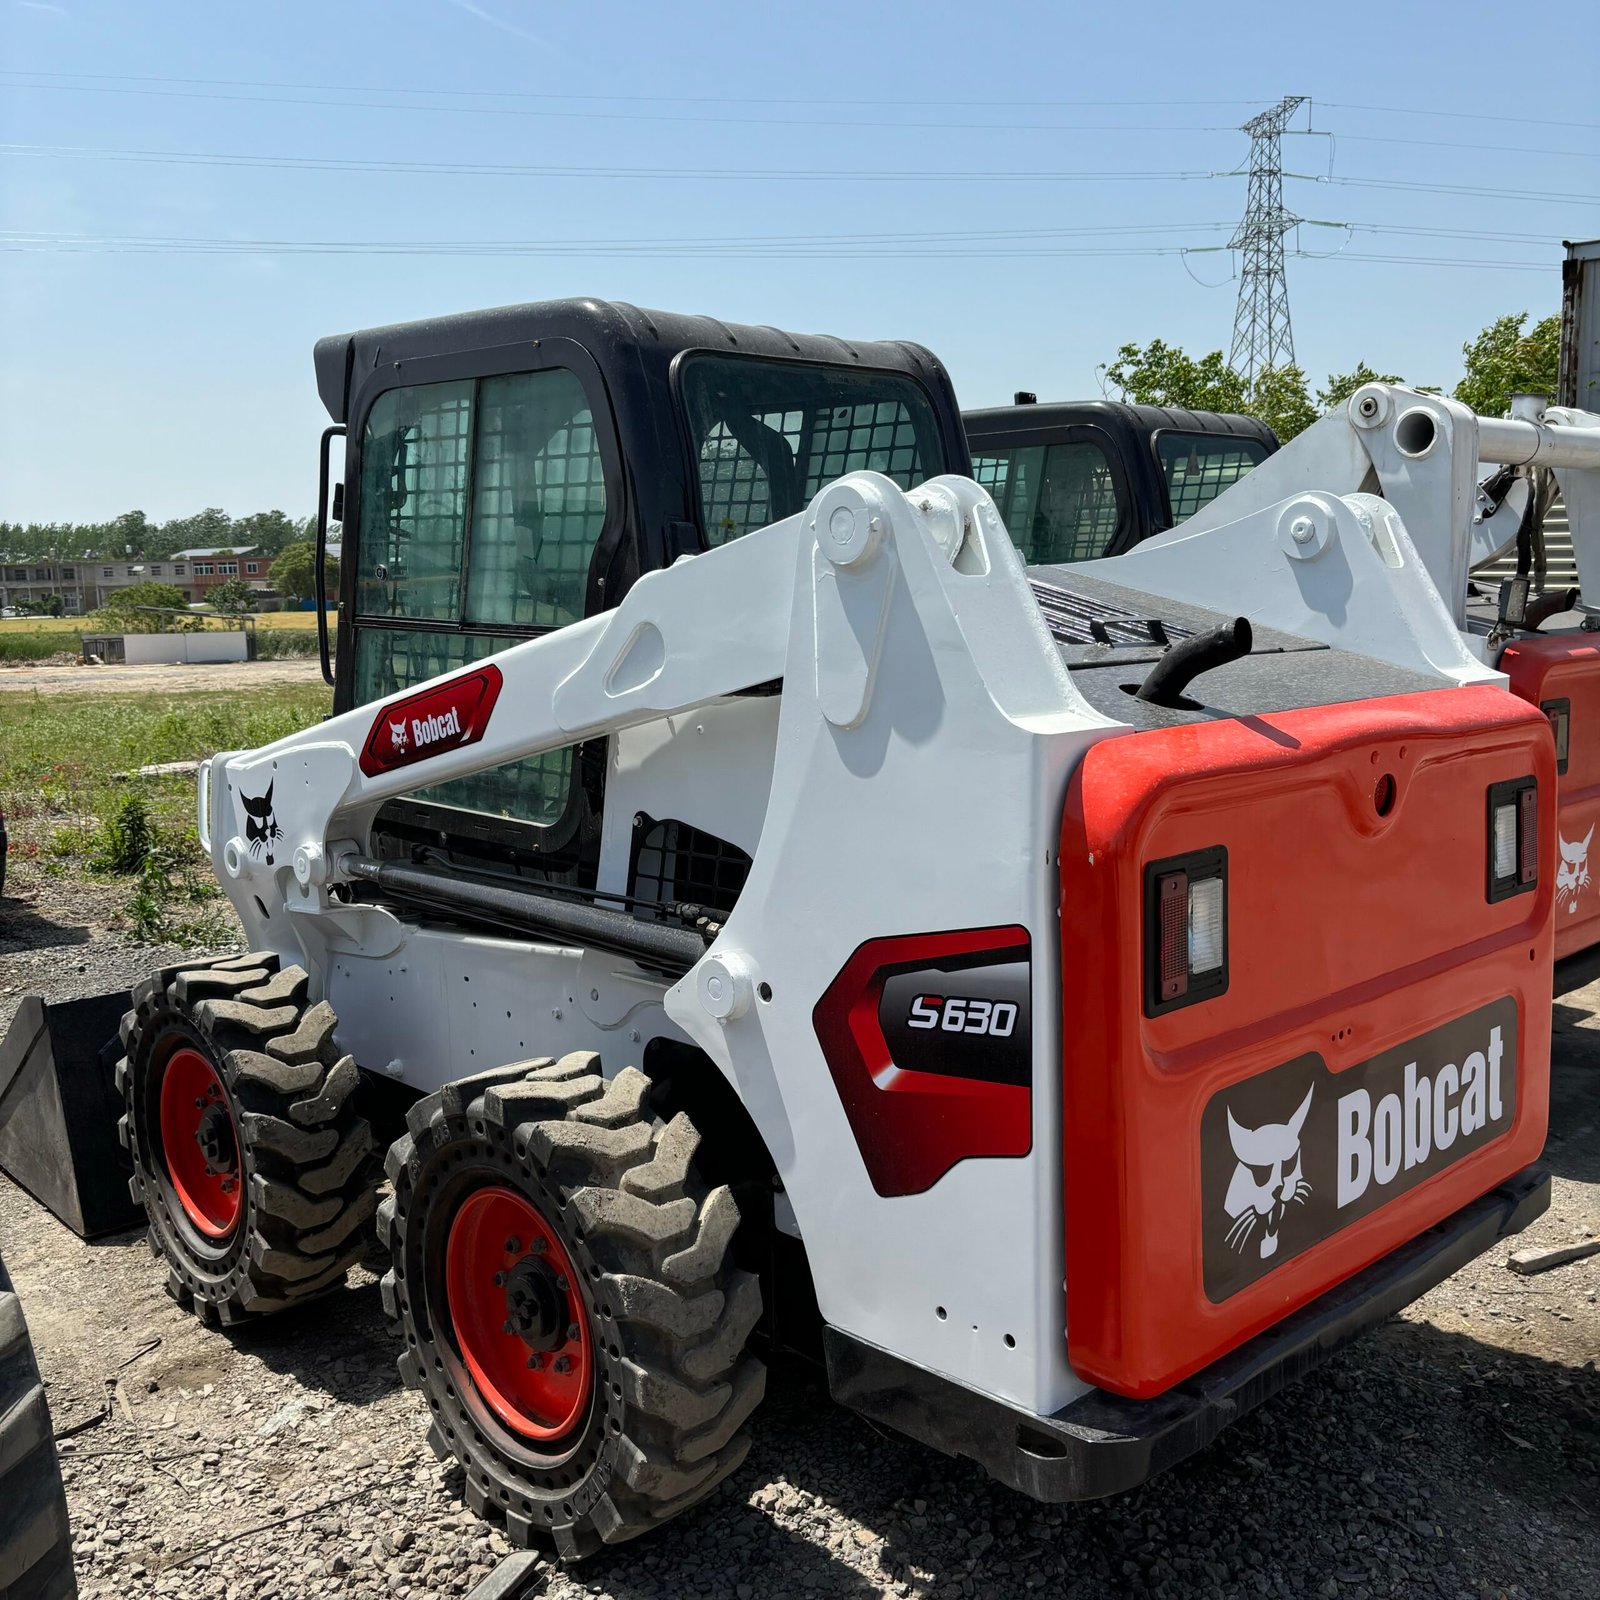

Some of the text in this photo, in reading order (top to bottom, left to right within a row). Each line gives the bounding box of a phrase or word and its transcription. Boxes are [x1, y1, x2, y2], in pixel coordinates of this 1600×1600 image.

[412, 706, 461, 747] Bobcat
[908, 996, 1017, 1037] S630
[1337, 1025, 1503, 1210] Bobcat
